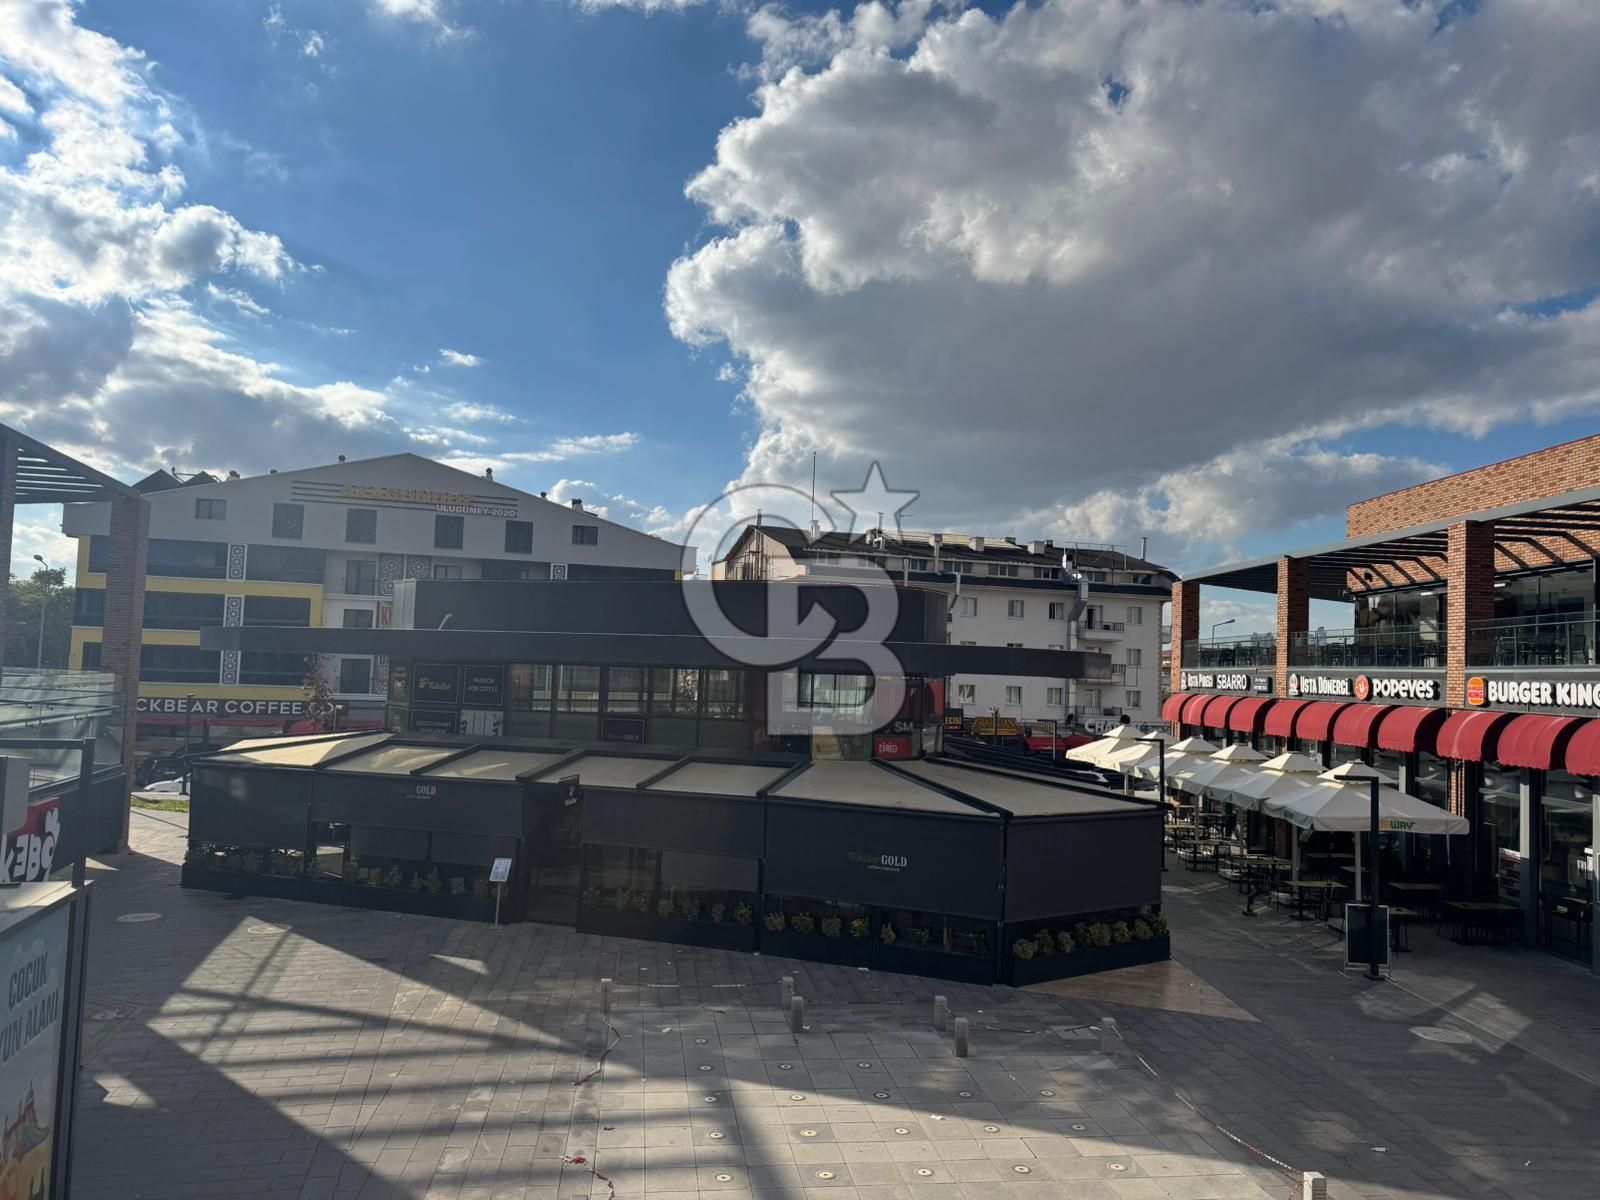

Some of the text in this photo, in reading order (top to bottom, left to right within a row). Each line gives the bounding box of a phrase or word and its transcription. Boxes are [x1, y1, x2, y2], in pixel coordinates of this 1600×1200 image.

[1216, 674, 1247, 690] SBARRO
[1300, 676, 1317, 694] USTA
[1488, 681, 1600, 707] BURGER KING
[224, 701, 304, 715] COFFEE
[416, 785, 437, 796] GOLD
[881, 855, 907, 867] GOLD
[24, 988, 59, 1046] ALANI
